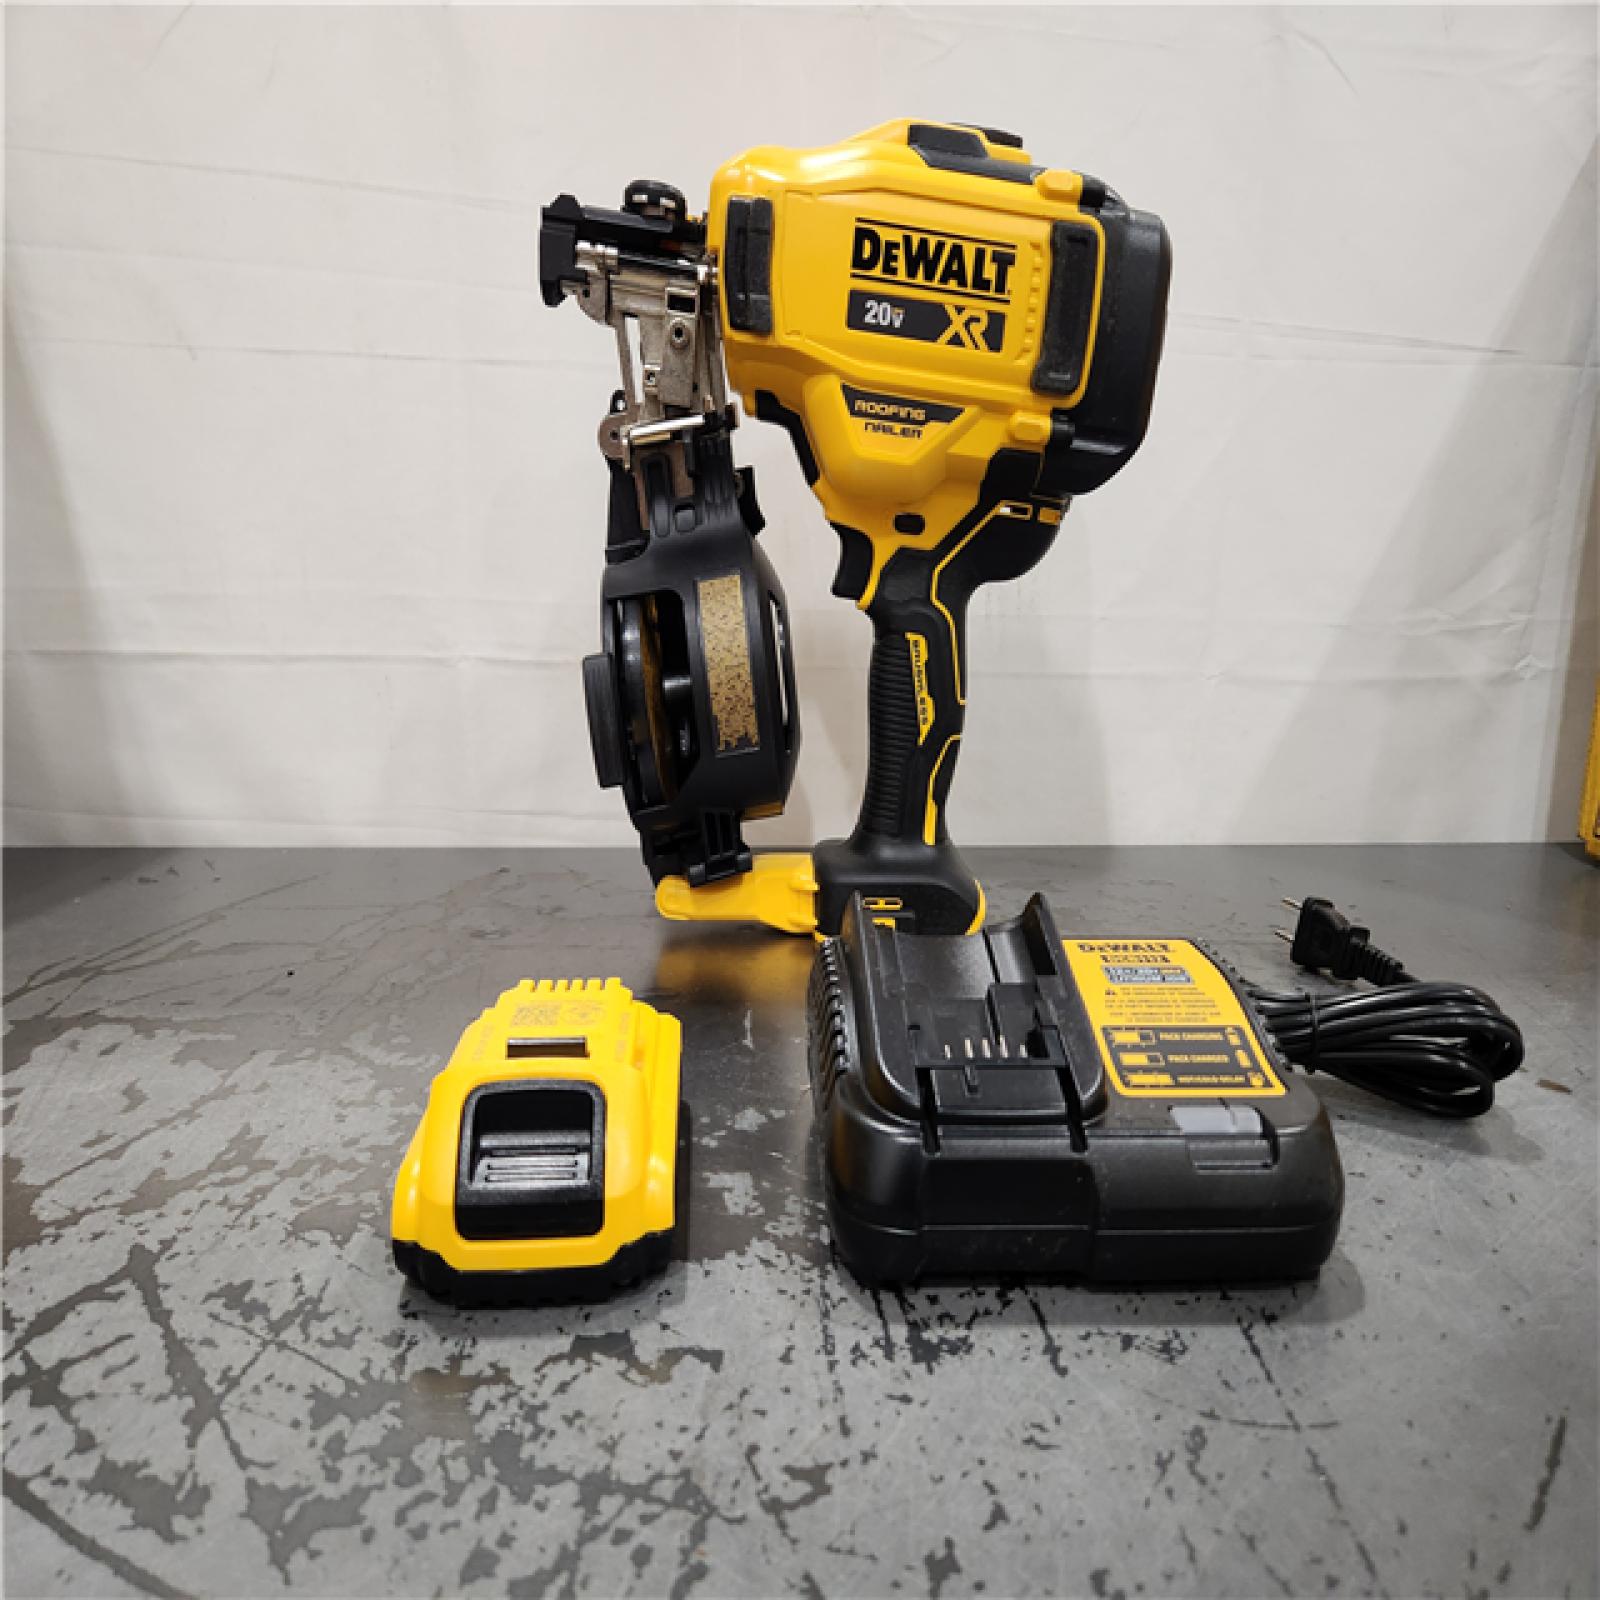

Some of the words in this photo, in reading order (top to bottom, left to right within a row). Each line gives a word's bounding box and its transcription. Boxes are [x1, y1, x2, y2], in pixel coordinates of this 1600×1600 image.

[937, 304, 989, 351] XR
[855, 400, 926, 420] ROOFING
[864, 422, 923, 438] NAILER
